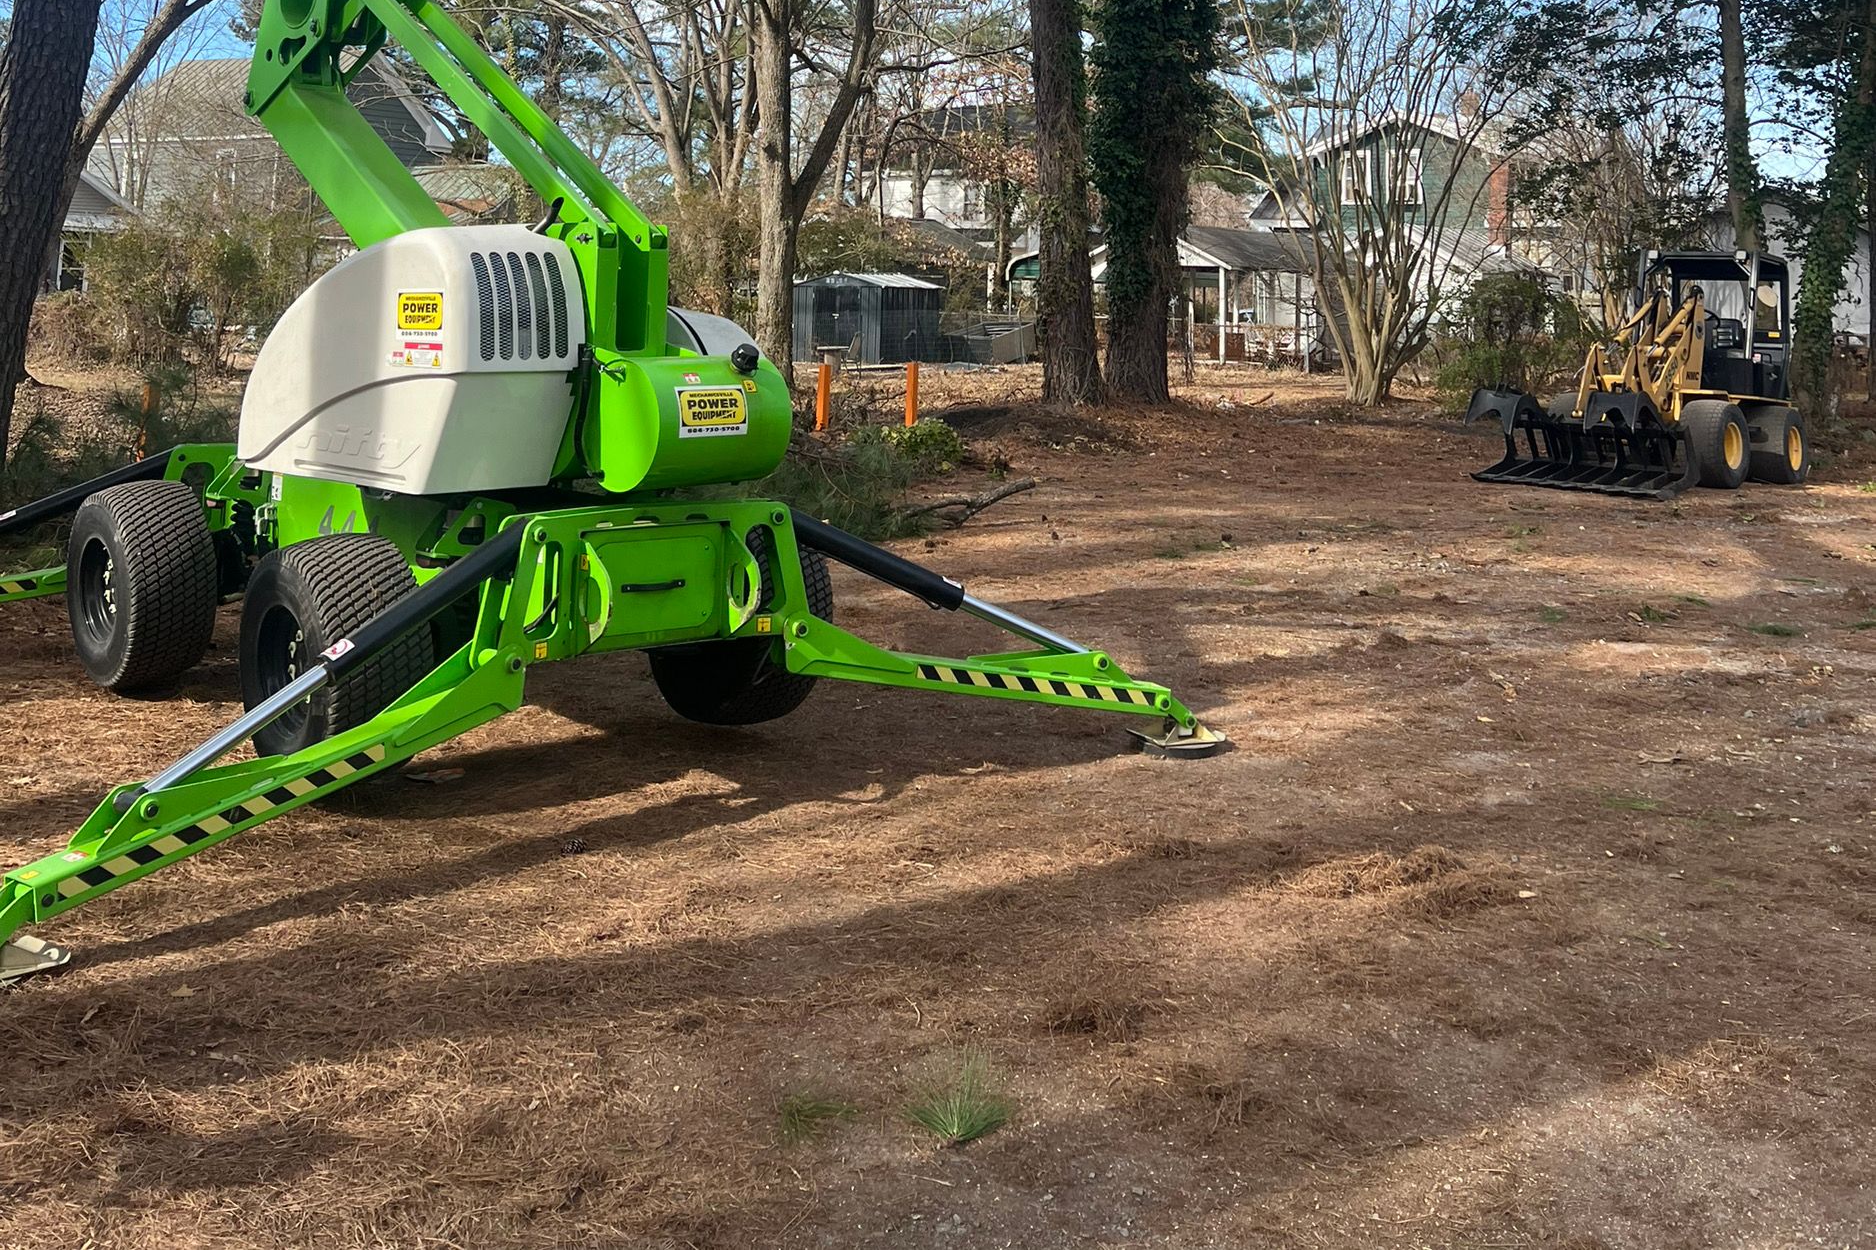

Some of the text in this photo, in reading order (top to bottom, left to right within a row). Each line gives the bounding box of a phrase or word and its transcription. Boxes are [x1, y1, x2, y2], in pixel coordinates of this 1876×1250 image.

[402, 303, 438, 313] POWER
[687, 398, 739, 410] POWER
[692, 410, 736, 421] EQUIPMENT
[297, 425, 422, 469] nifty
